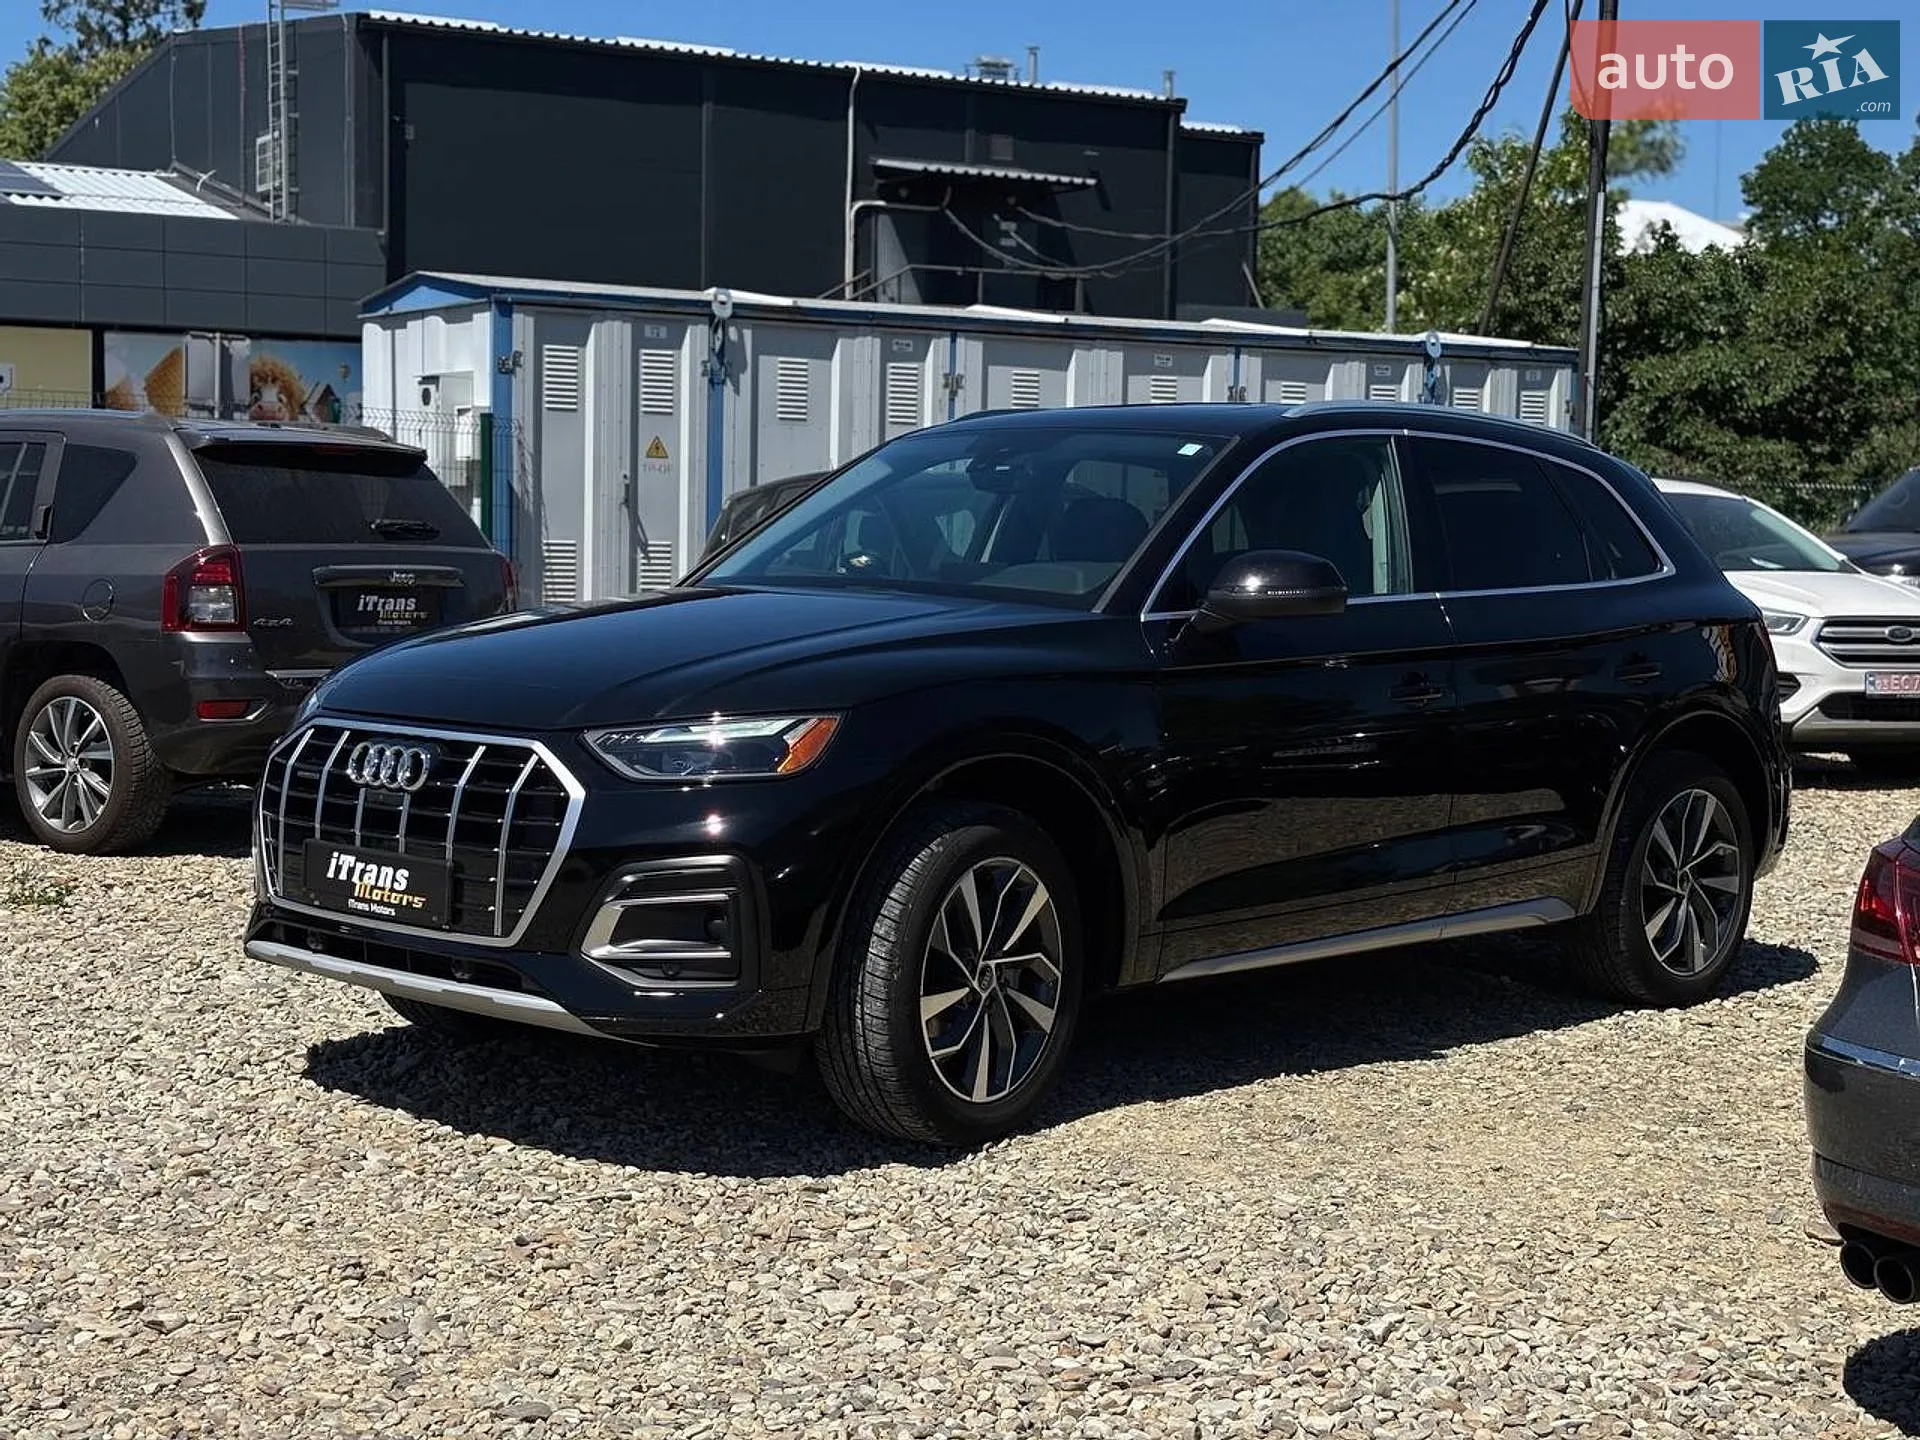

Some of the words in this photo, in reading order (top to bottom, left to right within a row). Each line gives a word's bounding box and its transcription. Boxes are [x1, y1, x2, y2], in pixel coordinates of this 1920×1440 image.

[357, 594, 417, 612] iTrans
[326, 851, 410, 891] iTrans
[353, 880, 428, 909] Motors
